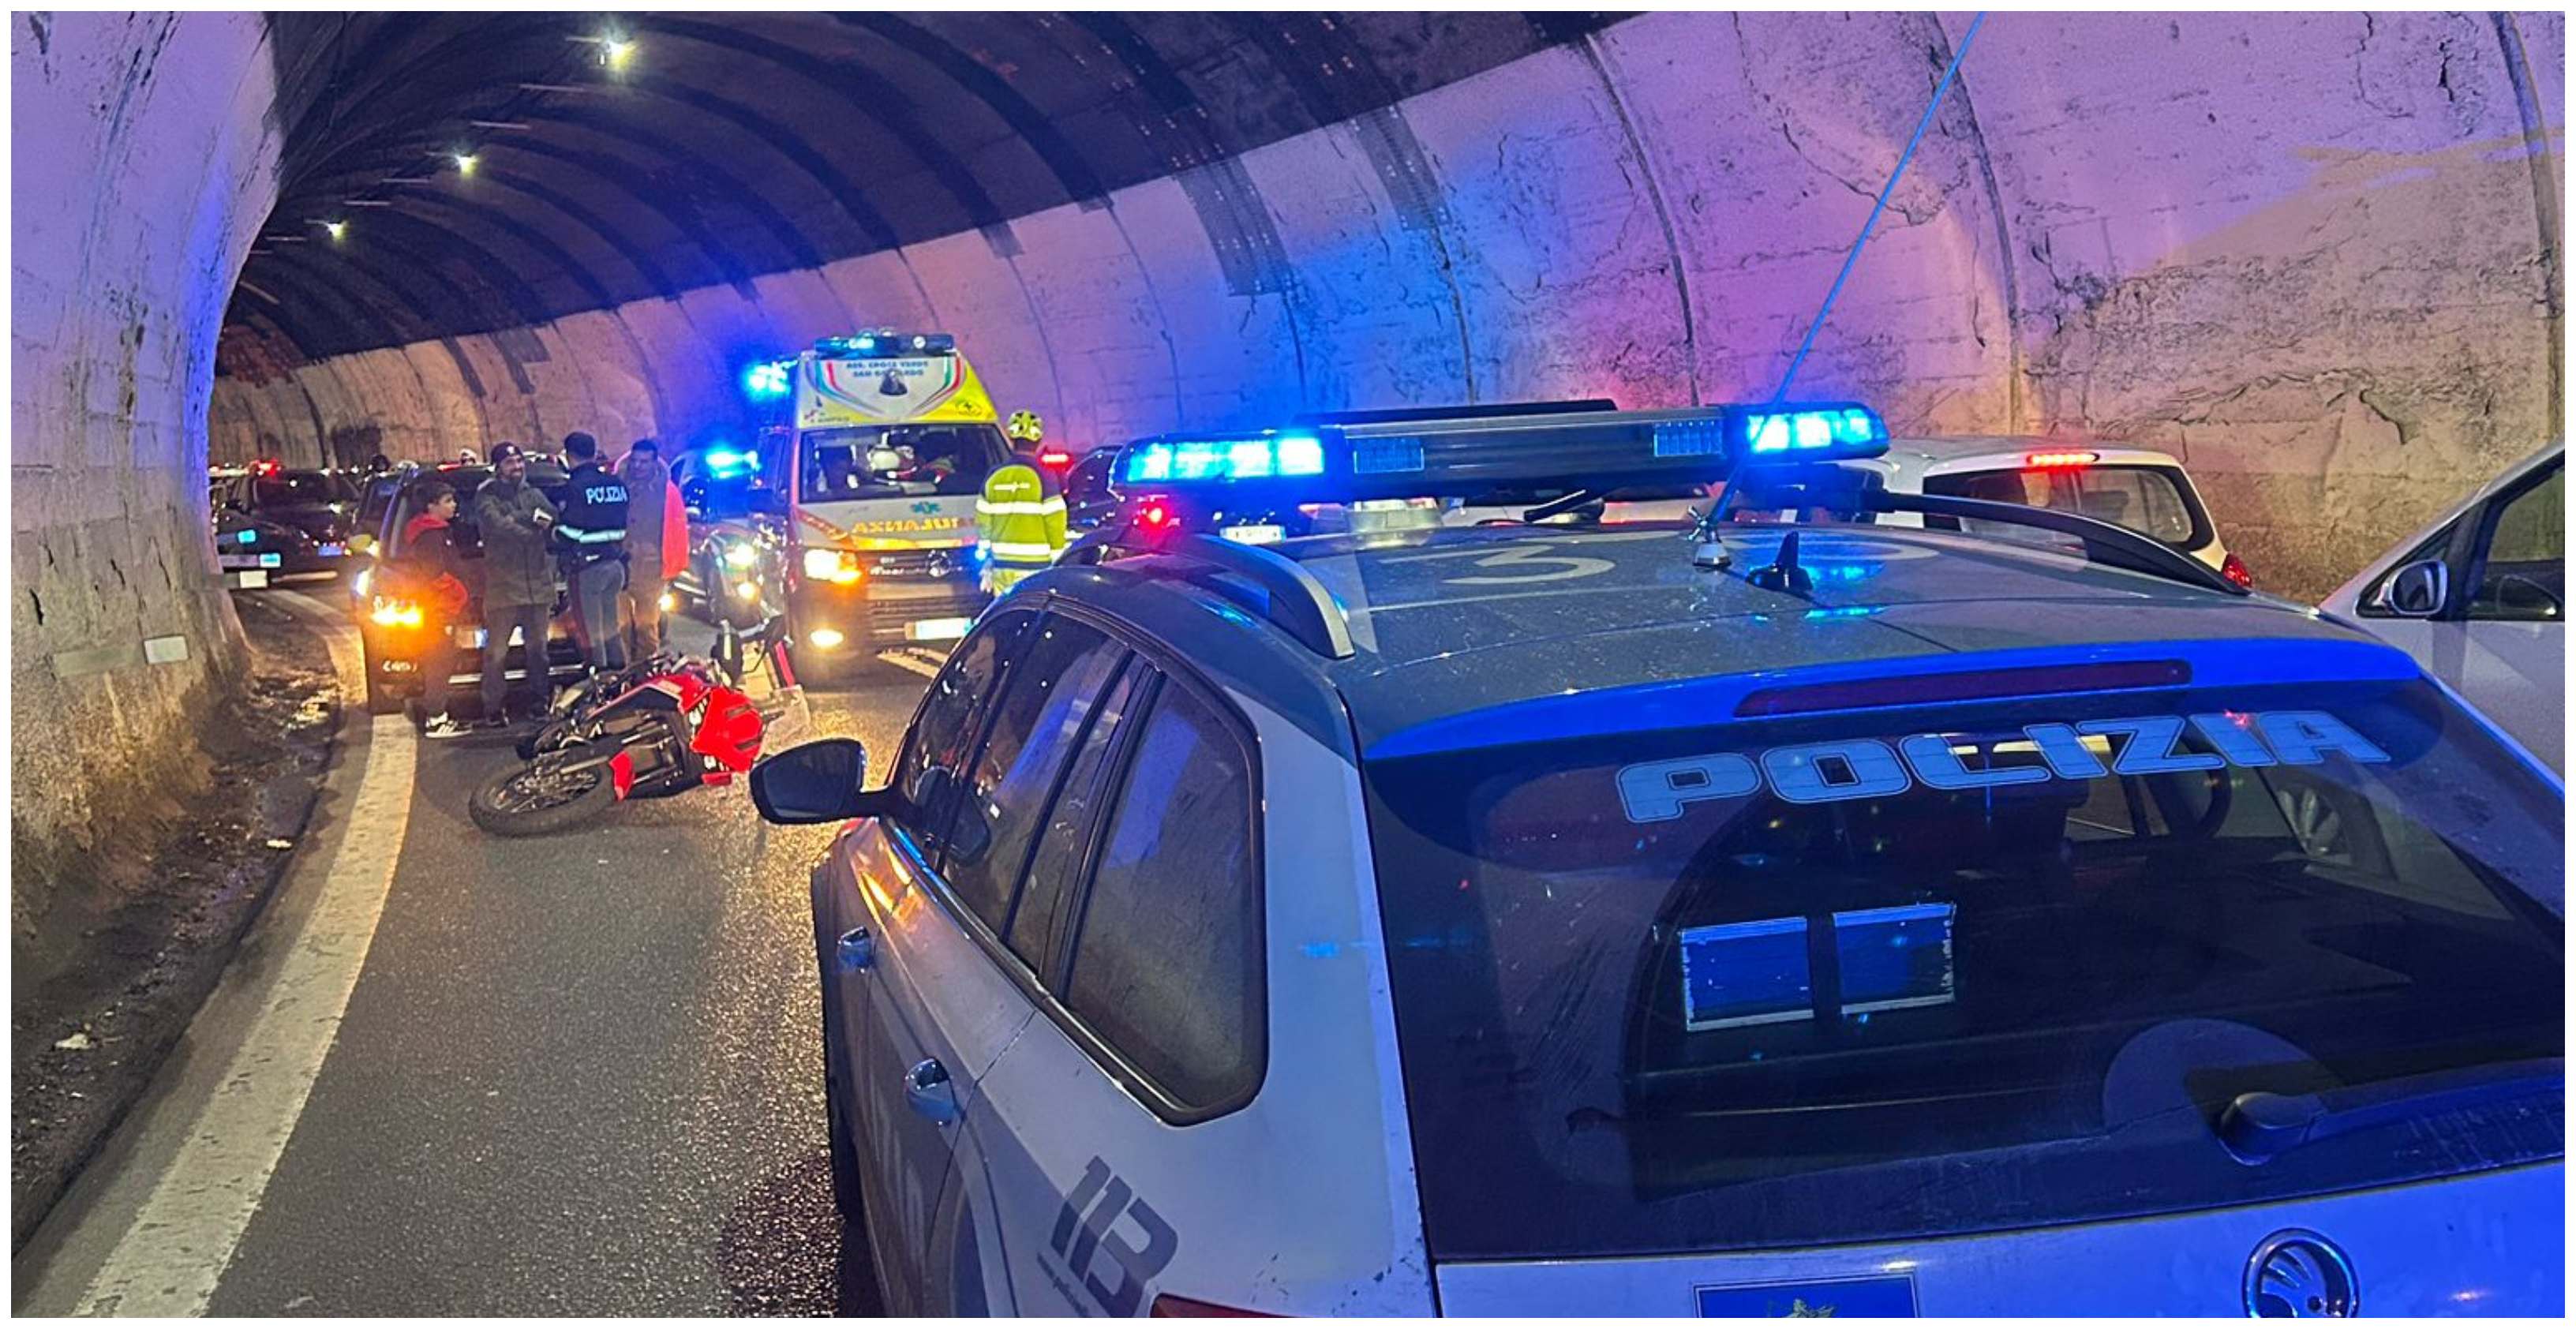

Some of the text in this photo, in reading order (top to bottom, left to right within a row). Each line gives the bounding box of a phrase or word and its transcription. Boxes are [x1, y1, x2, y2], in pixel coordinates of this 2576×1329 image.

[586, 485, 628, 504] POLIZIA
[1615, 710, 2392, 823] POLIZIA
[1050, 1155, 1179, 1317] 113
